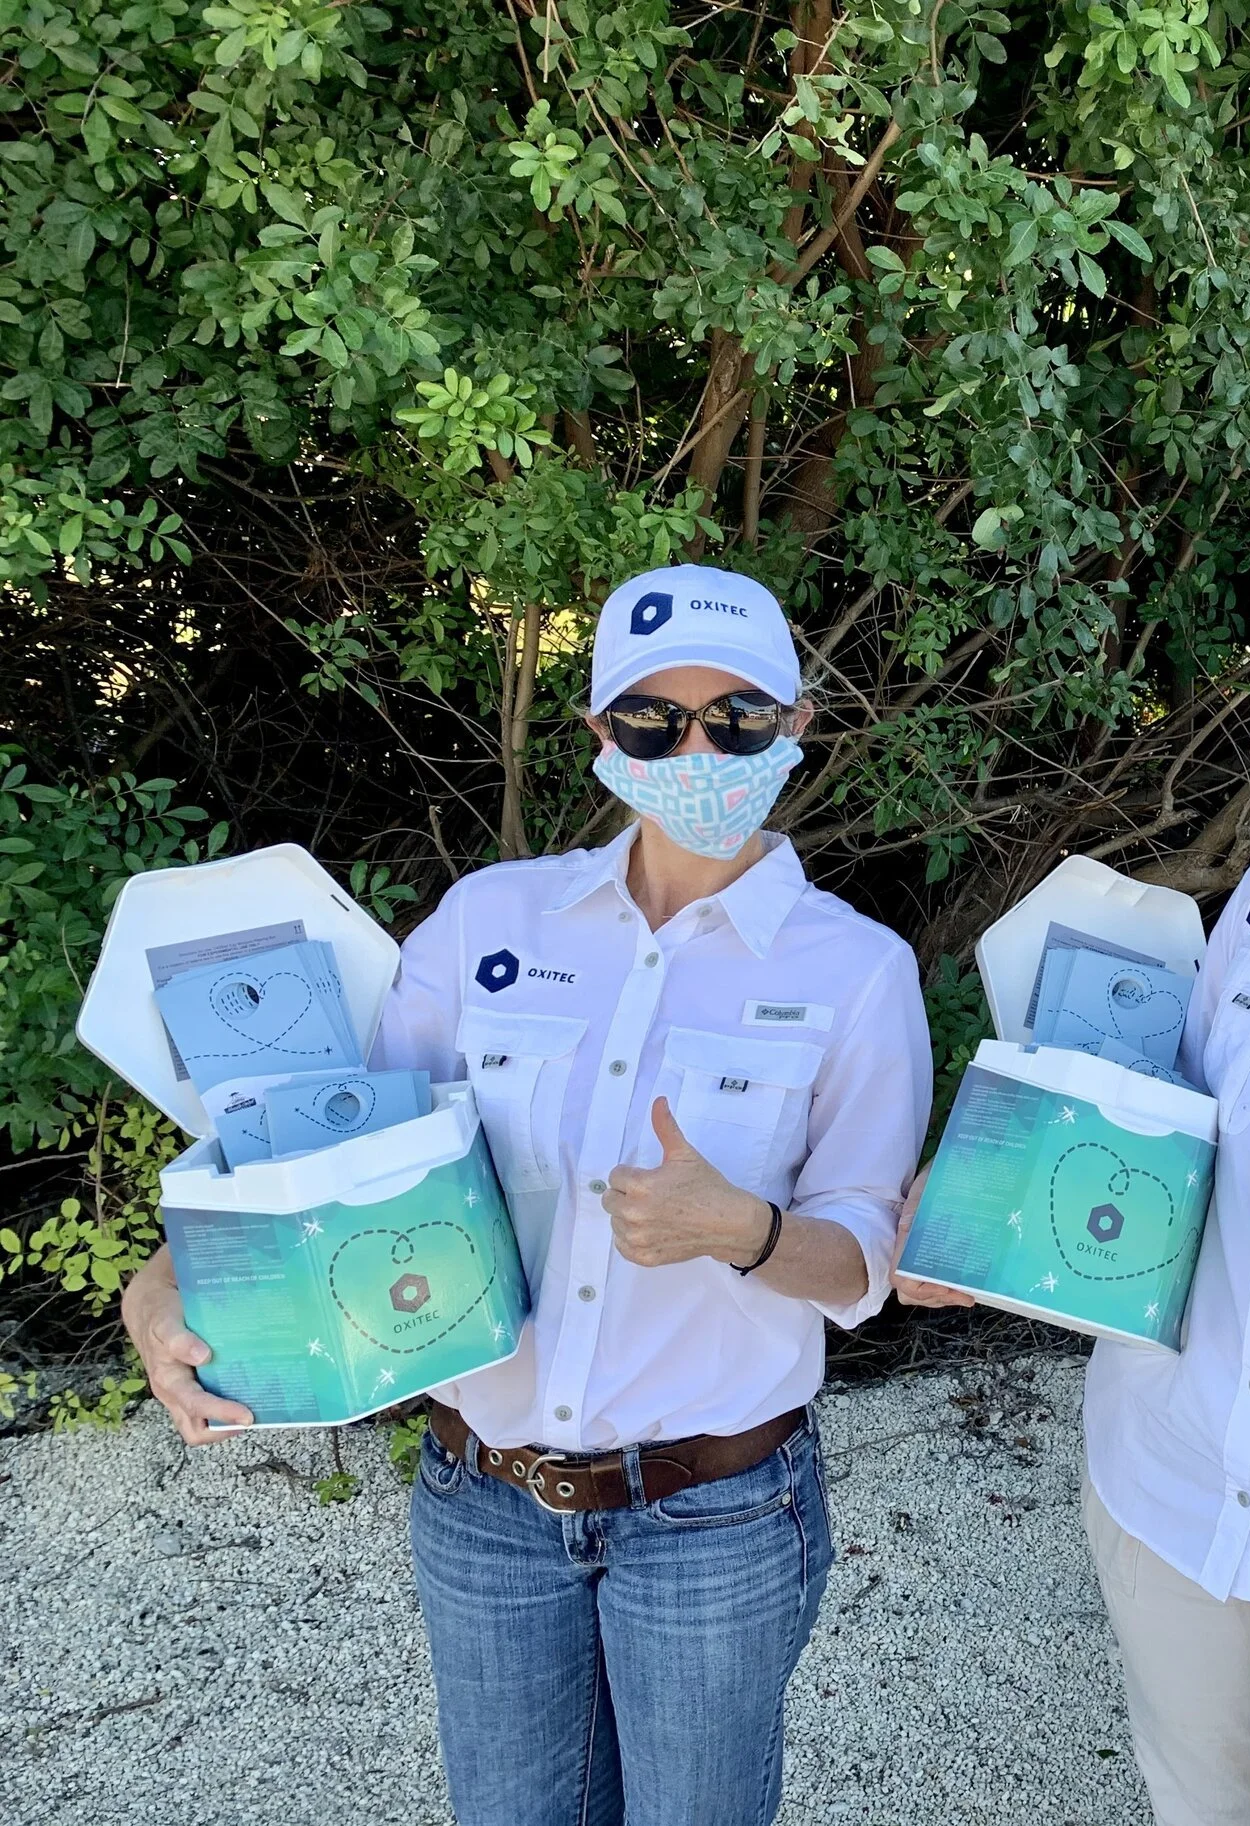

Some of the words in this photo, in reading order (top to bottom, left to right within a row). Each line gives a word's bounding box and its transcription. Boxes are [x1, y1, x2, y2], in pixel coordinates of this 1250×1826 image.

[690, 599, 749, 618] OXITEC
[527, 967, 576, 984] OXITEC
[1076, 1241, 1119, 1262] OXITEC
[393, 1310, 441, 1334] OXITEC
